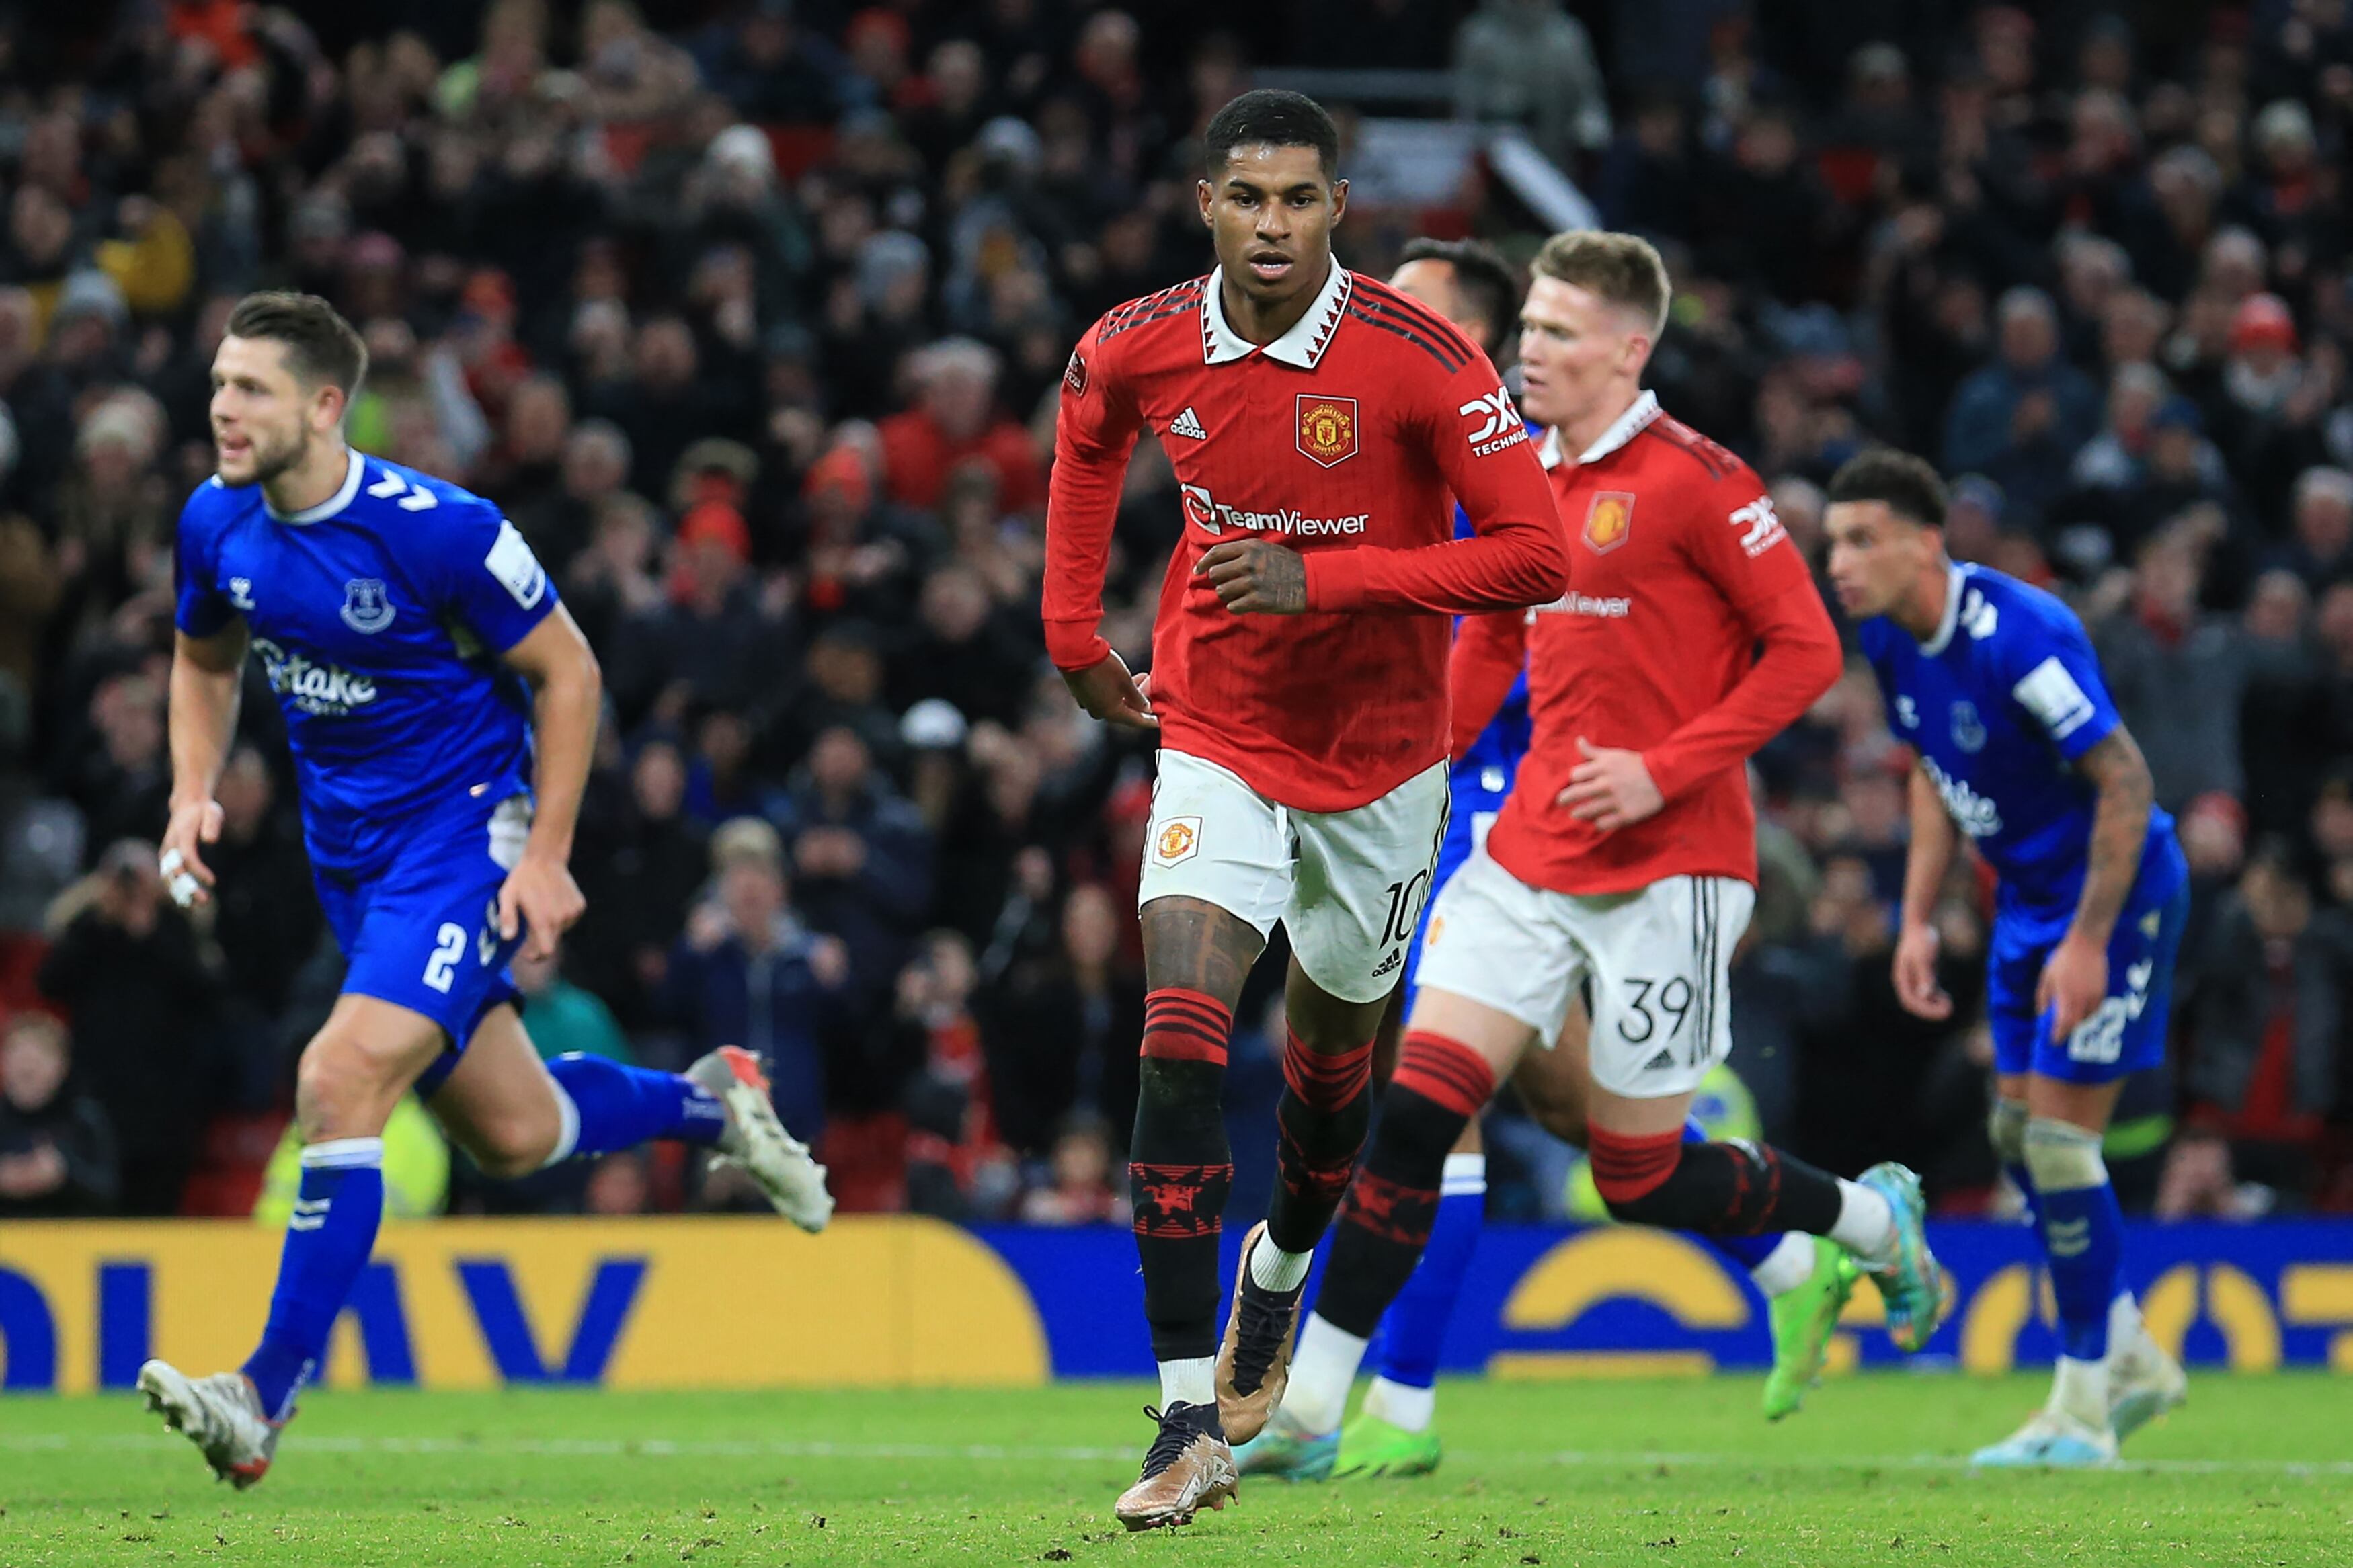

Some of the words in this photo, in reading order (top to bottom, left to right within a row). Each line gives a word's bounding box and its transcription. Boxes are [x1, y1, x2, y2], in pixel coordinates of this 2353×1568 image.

[1170, 423, 1207, 440] adidas
[1215, 503, 1369, 535] TeamViewer
[1378, 868, 1428, 950] 10
[422, 921, 468, 995] 2
[1618, 976, 1695, 1044] 39
